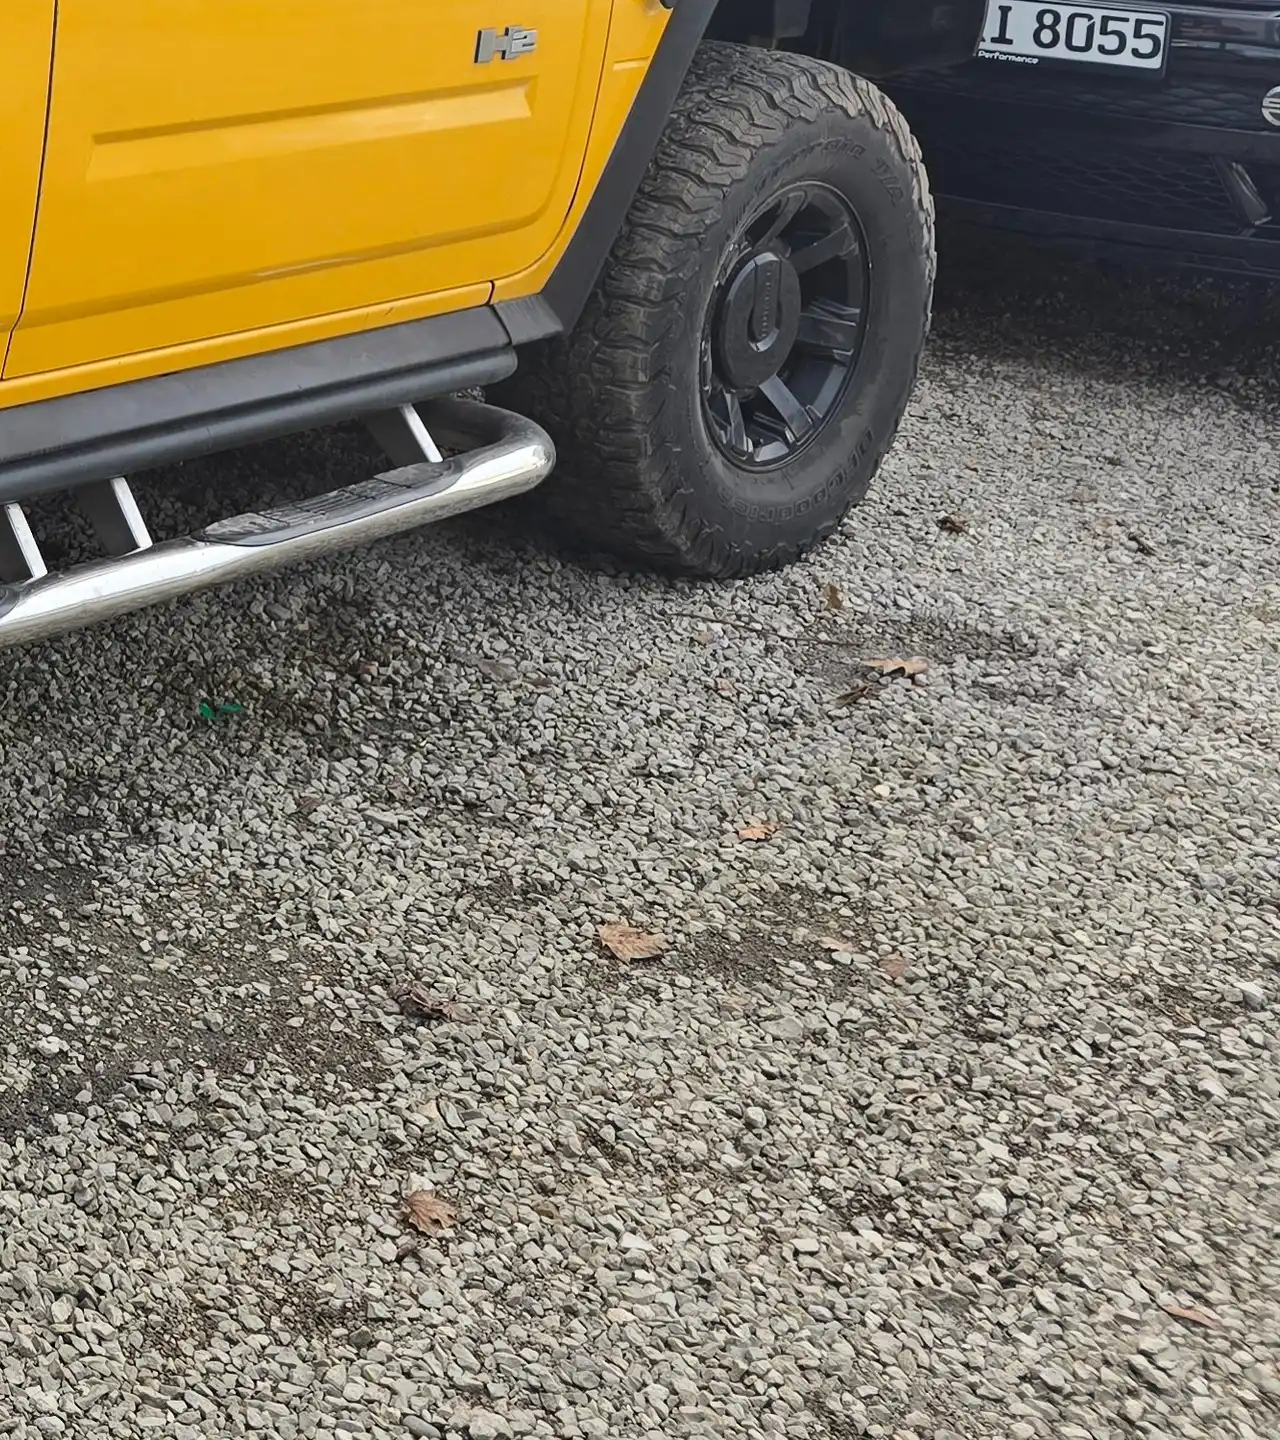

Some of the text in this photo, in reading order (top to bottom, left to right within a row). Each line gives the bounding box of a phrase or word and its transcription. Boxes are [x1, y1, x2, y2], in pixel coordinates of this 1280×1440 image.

[473, 24, 539, 64] H2
[981, 5, 1165, 60] I 8055
[977, 49, 1040, 65] Performance
